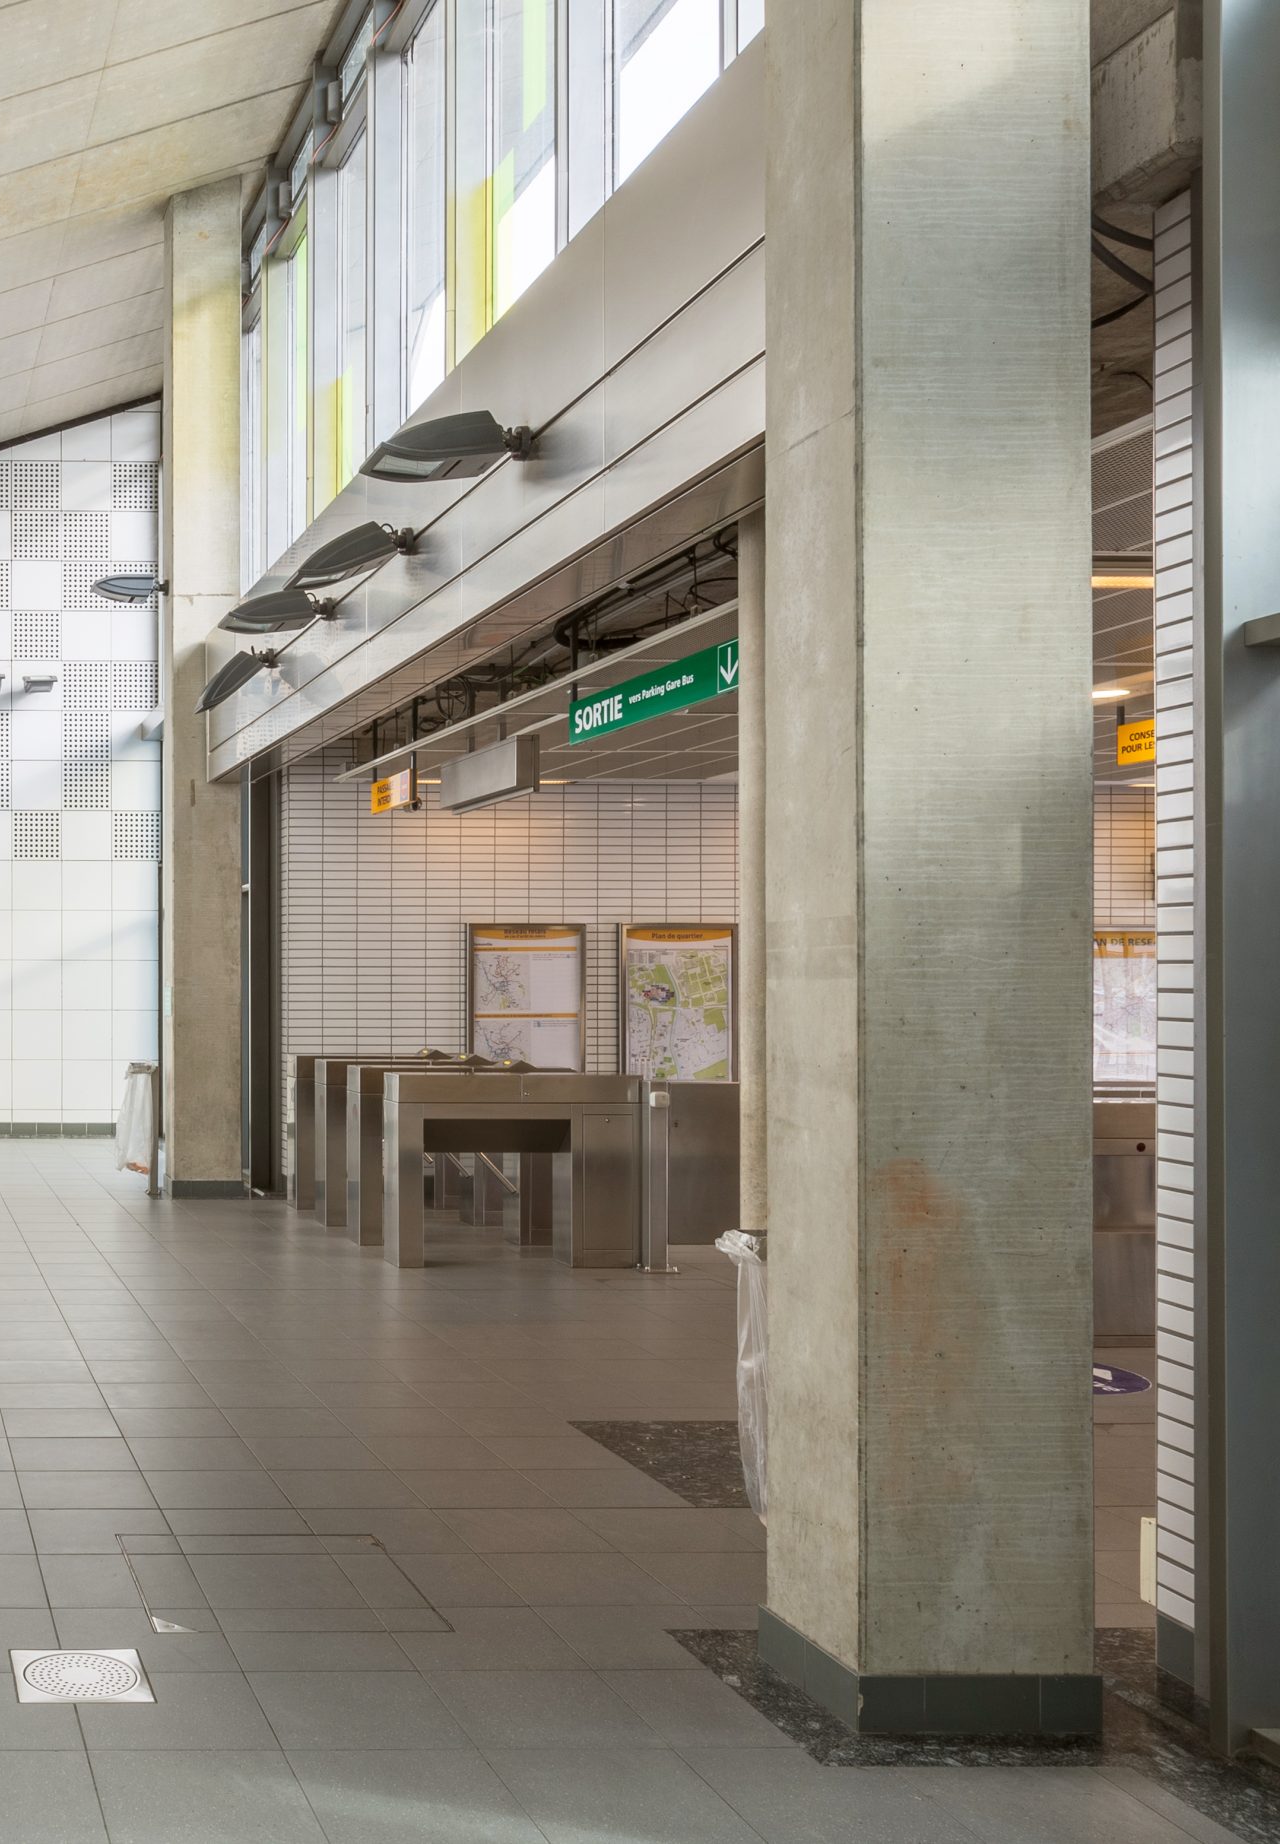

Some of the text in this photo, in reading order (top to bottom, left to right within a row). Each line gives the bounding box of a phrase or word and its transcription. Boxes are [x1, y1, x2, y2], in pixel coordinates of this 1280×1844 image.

[574, 674, 694, 734] SORTIE vers Parking Gare Bus
[1121, 741, 1154, 754] POUR LE
[676, 932, 703, 940] quartier
[1110, 938, 1124, 946] DE
